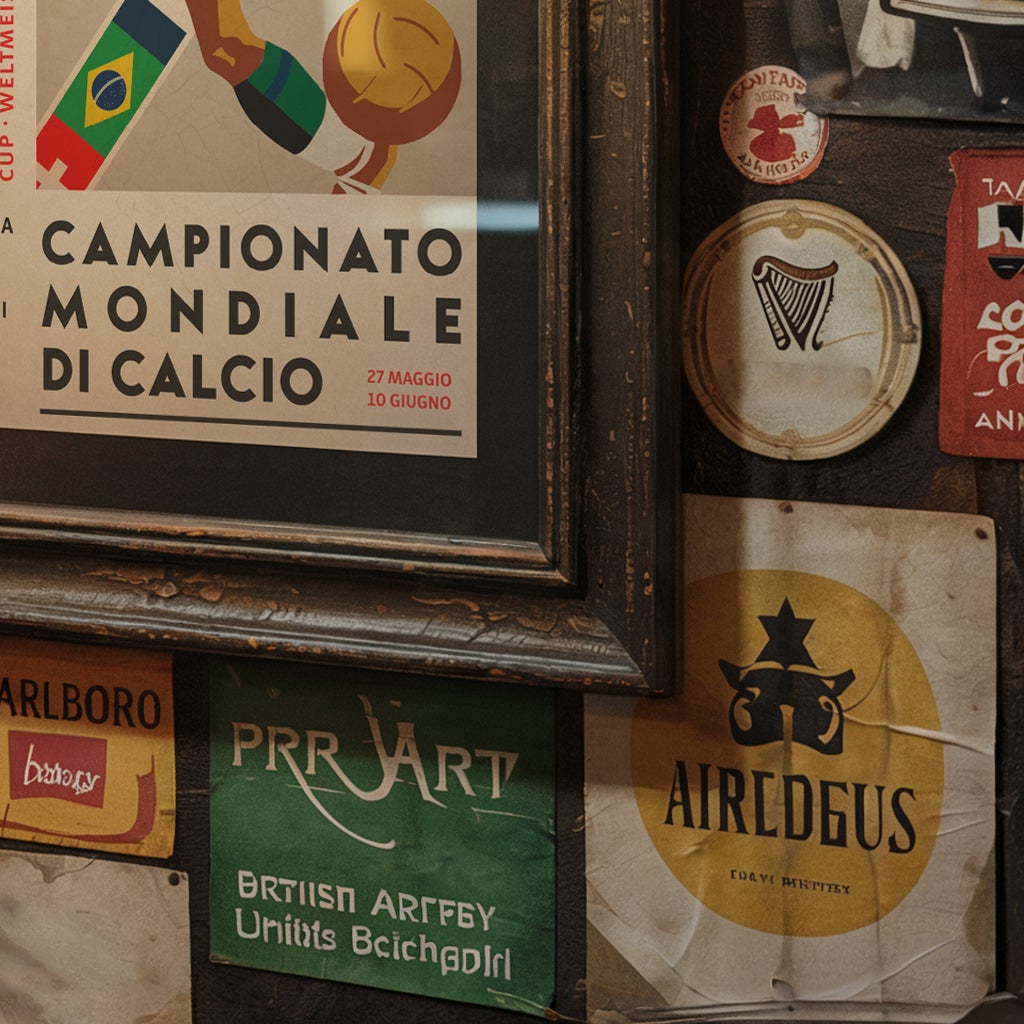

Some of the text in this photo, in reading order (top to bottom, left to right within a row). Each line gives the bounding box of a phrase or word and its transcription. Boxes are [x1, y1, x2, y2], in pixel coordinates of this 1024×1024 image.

[0, 135, 14, 182] CUP
[41, 219, 463, 277] CAMPIONATO
[41, 284, 462, 345] MONDIALE
[43, 347, 323, 406] DI CALCIO
[367, 369, 452, 388] 27 MAGGIO
[367, 392, 452, 411] 10 GIUGNO
